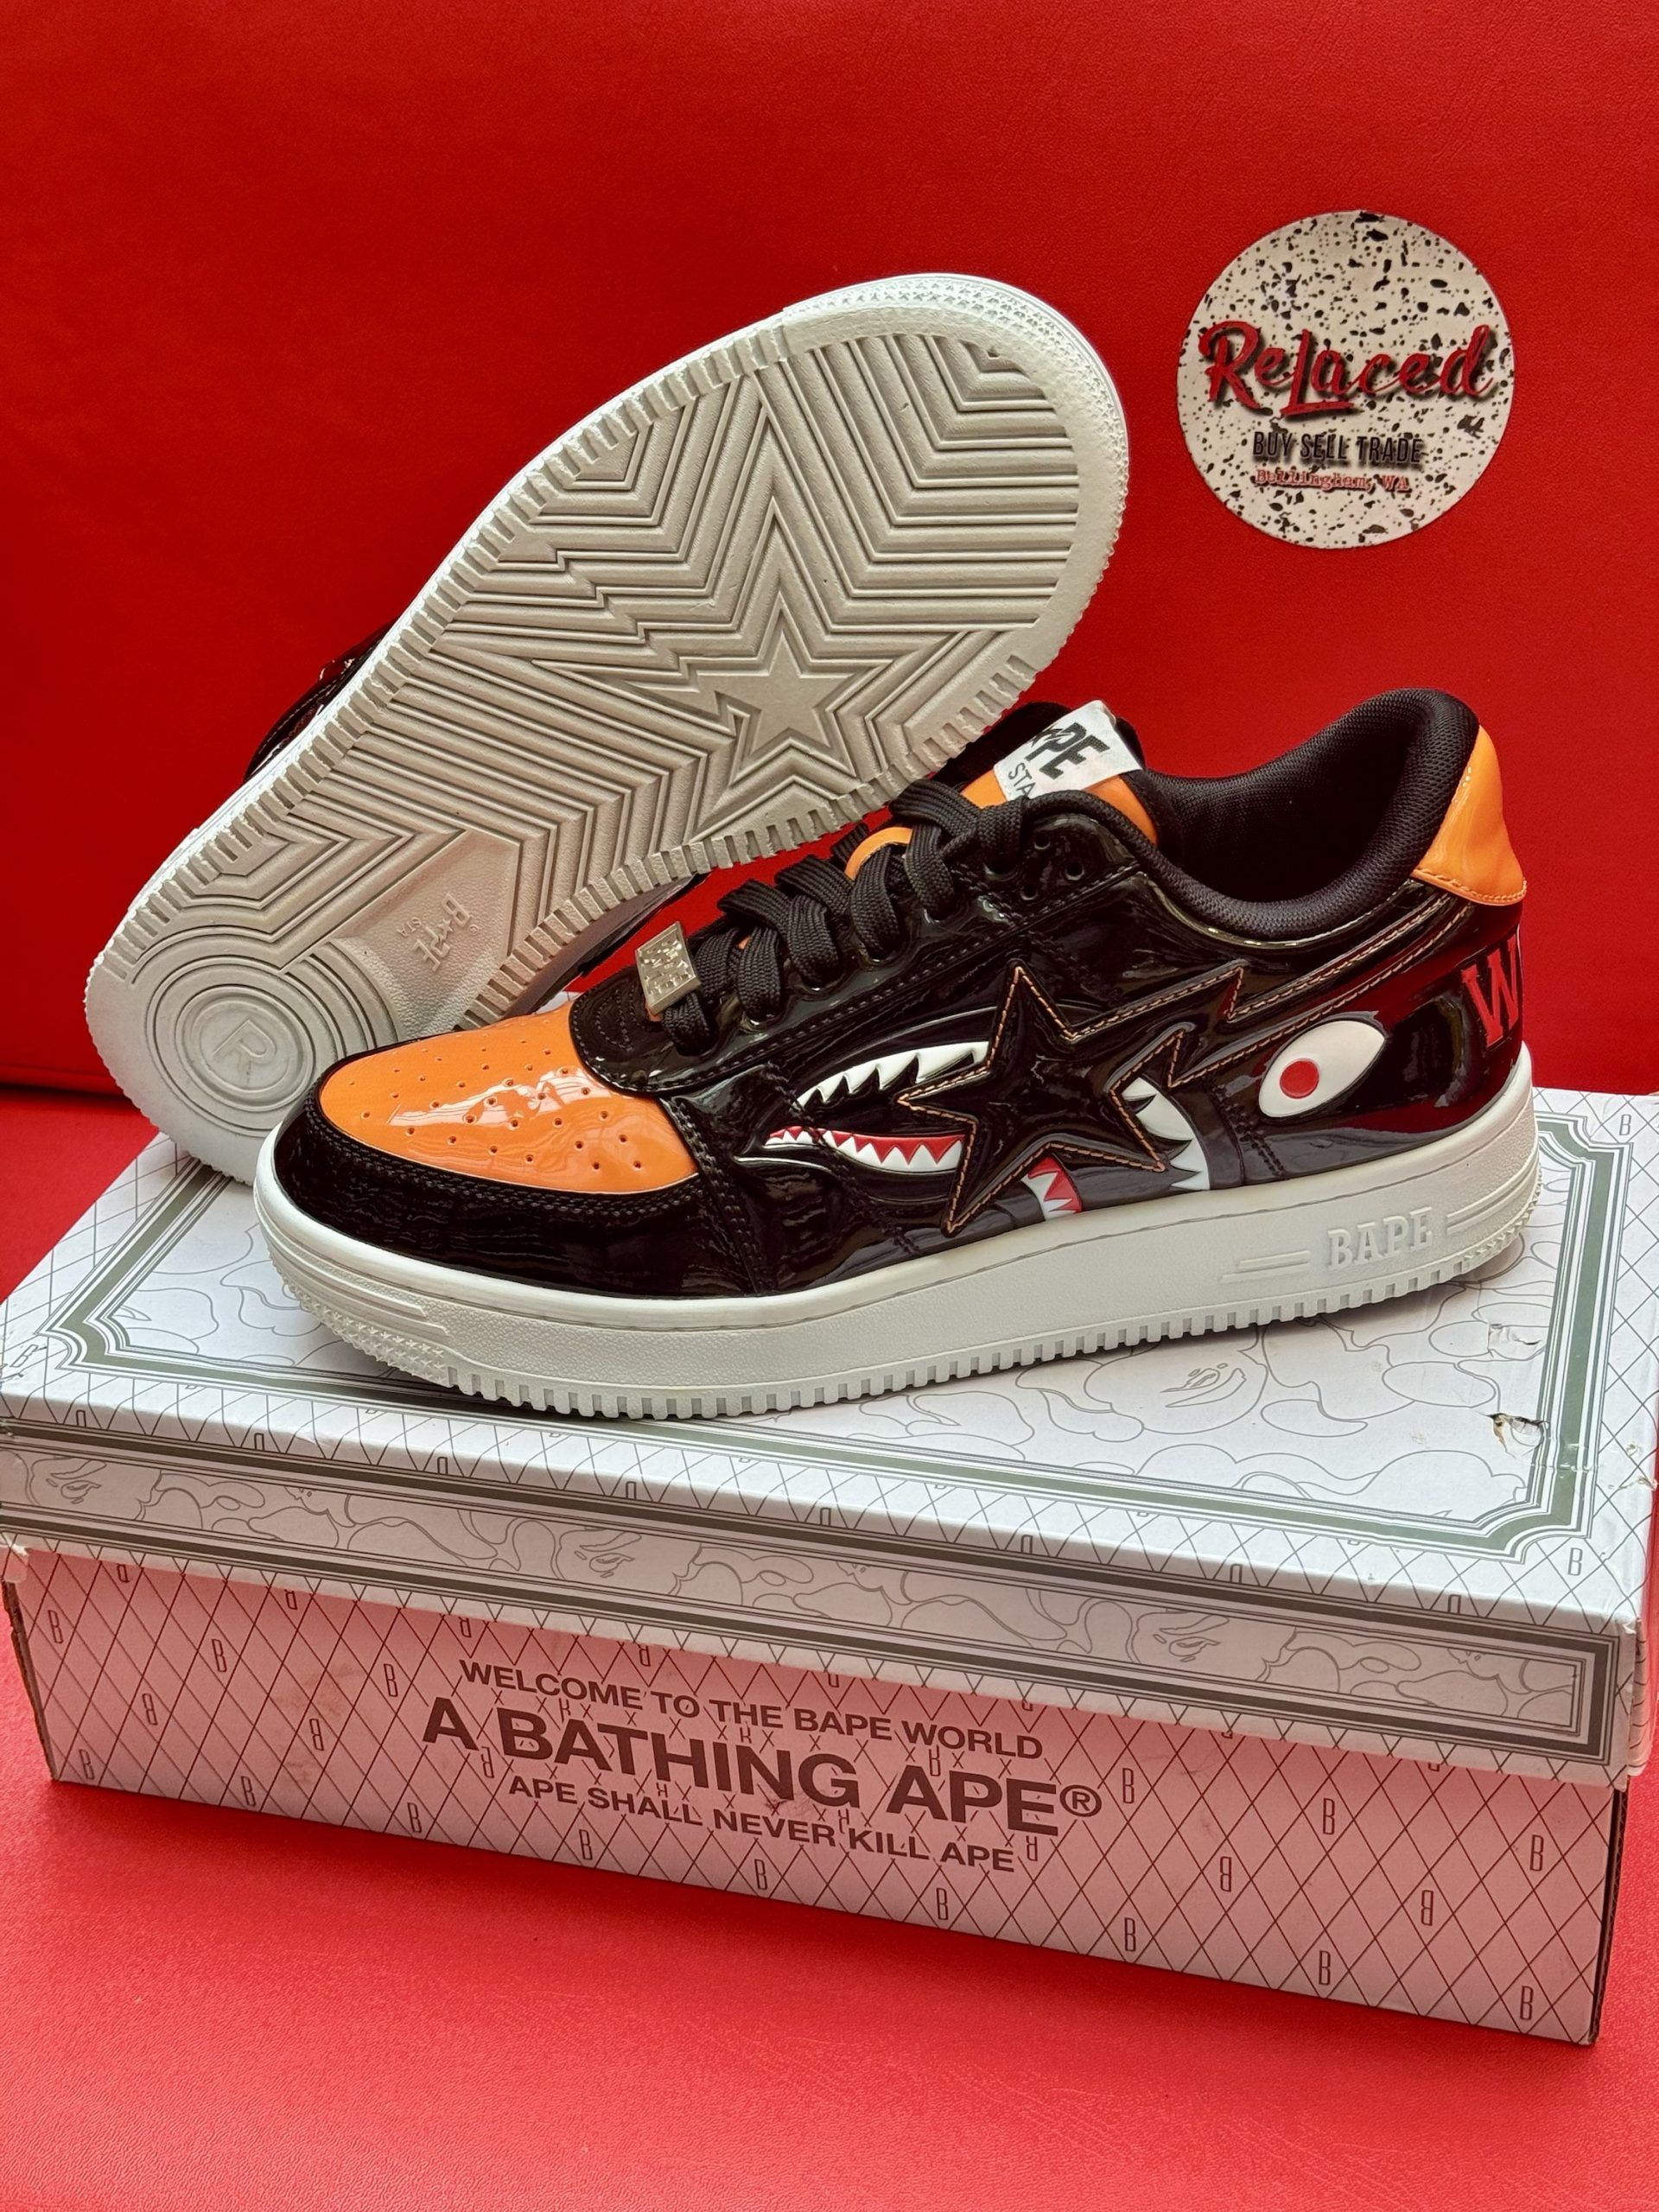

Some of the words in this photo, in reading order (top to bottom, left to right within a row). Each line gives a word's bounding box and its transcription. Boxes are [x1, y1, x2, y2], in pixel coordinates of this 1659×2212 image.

[1253, 431, 1294, 458] BUY
[1300, 433, 1348, 461] SELL
[1356, 435, 1423, 464] TRADE
[1255, 468, 1374, 493] Bellingham,
[1381, 474, 1411, 493] WA
[1326, 1206, 1433, 1272] BAPE
[459, 1659, 644, 1710] WELCOME
[651, 1690, 700, 1719] TO
[709, 1699, 784, 1729] THE
[793, 1707, 893, 1741] BAPE
[901, 1720, 1043, 1759] WORLD
[422, 1696, 479, 1751] A
[496, 1707, 861, 1808] BATHING
[509, 1775, 578, 1805] APE
[588, 1786, 703, 1827] SHALL
[714, 1808, 836, 1847] NEVER
[849, 1827, 930, 1860] KILL
[940, 1841, 1015, 1873] APE
